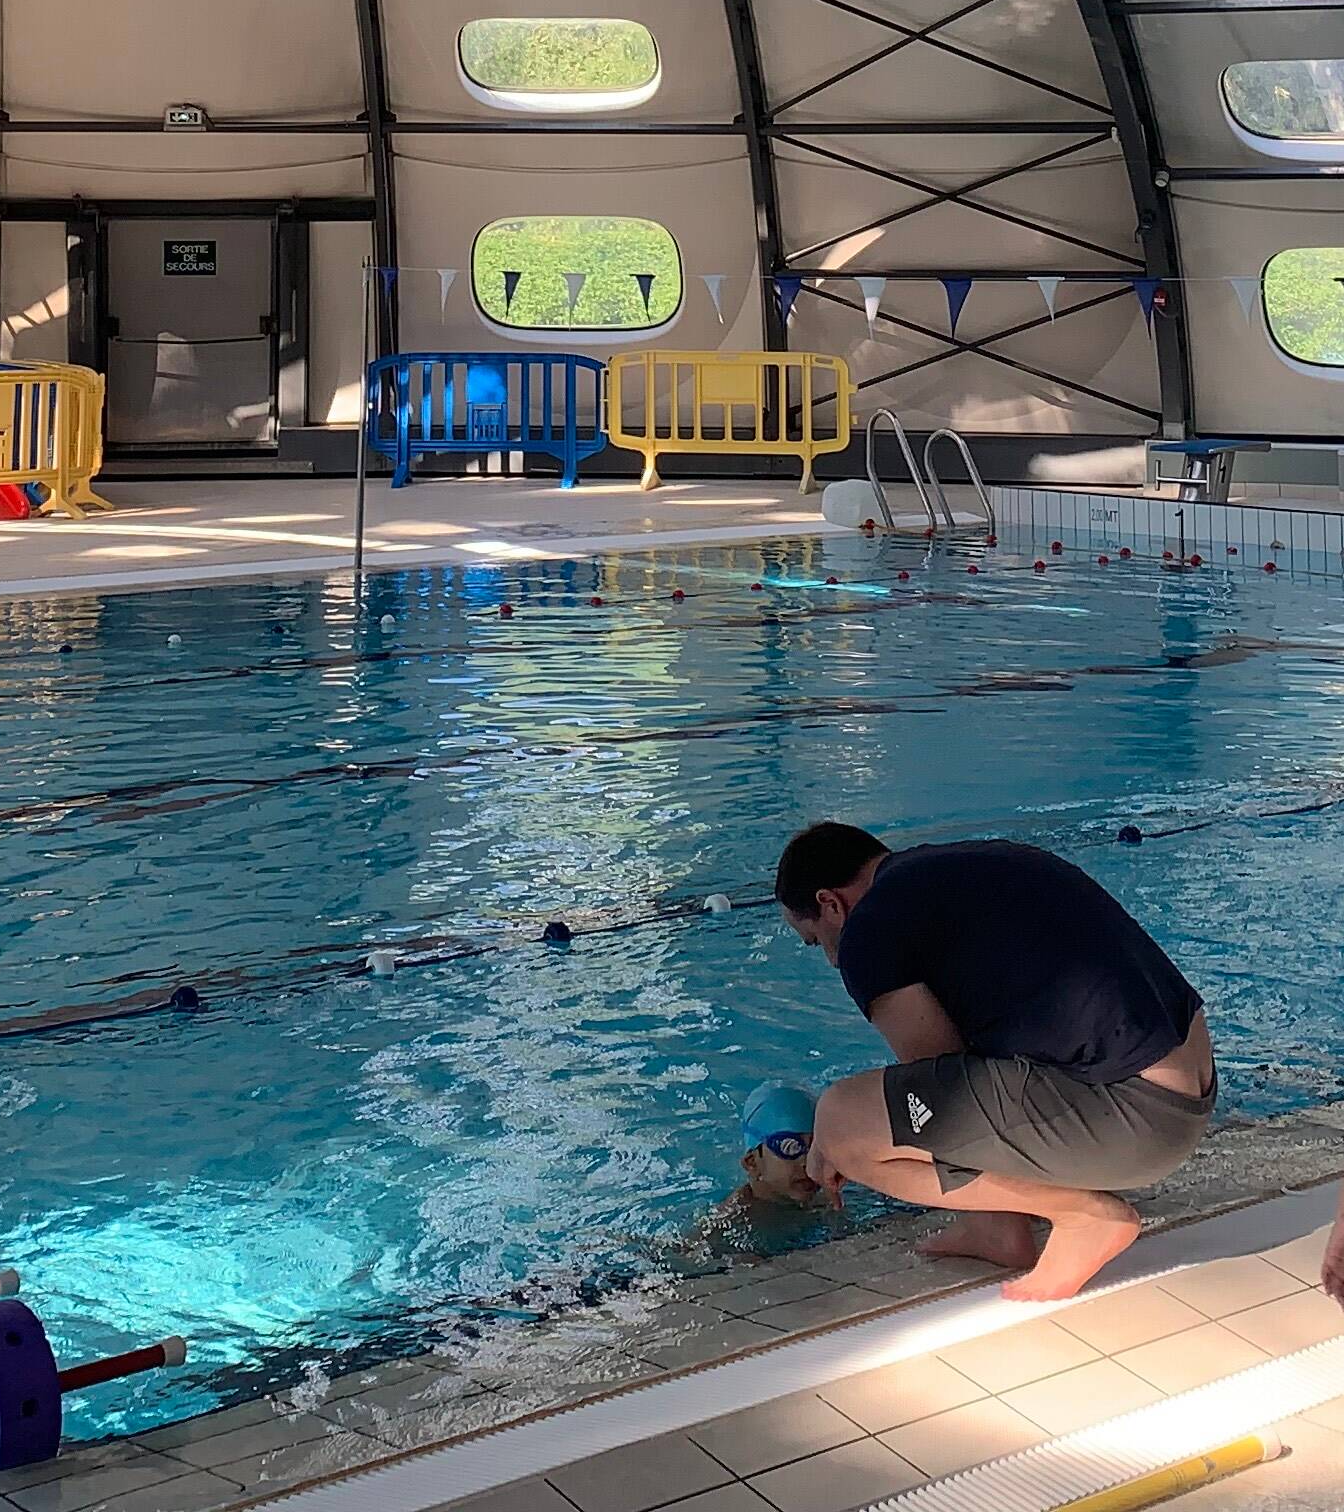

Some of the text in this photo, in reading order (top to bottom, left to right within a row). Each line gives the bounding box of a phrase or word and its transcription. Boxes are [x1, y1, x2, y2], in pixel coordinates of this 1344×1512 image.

[171, 244, 209, 254] SORTIE
[183, 253, 197, 262] DE
[166, 262, 215, 271] SECOURS
[907, 1092, 921, 1134] adidas
